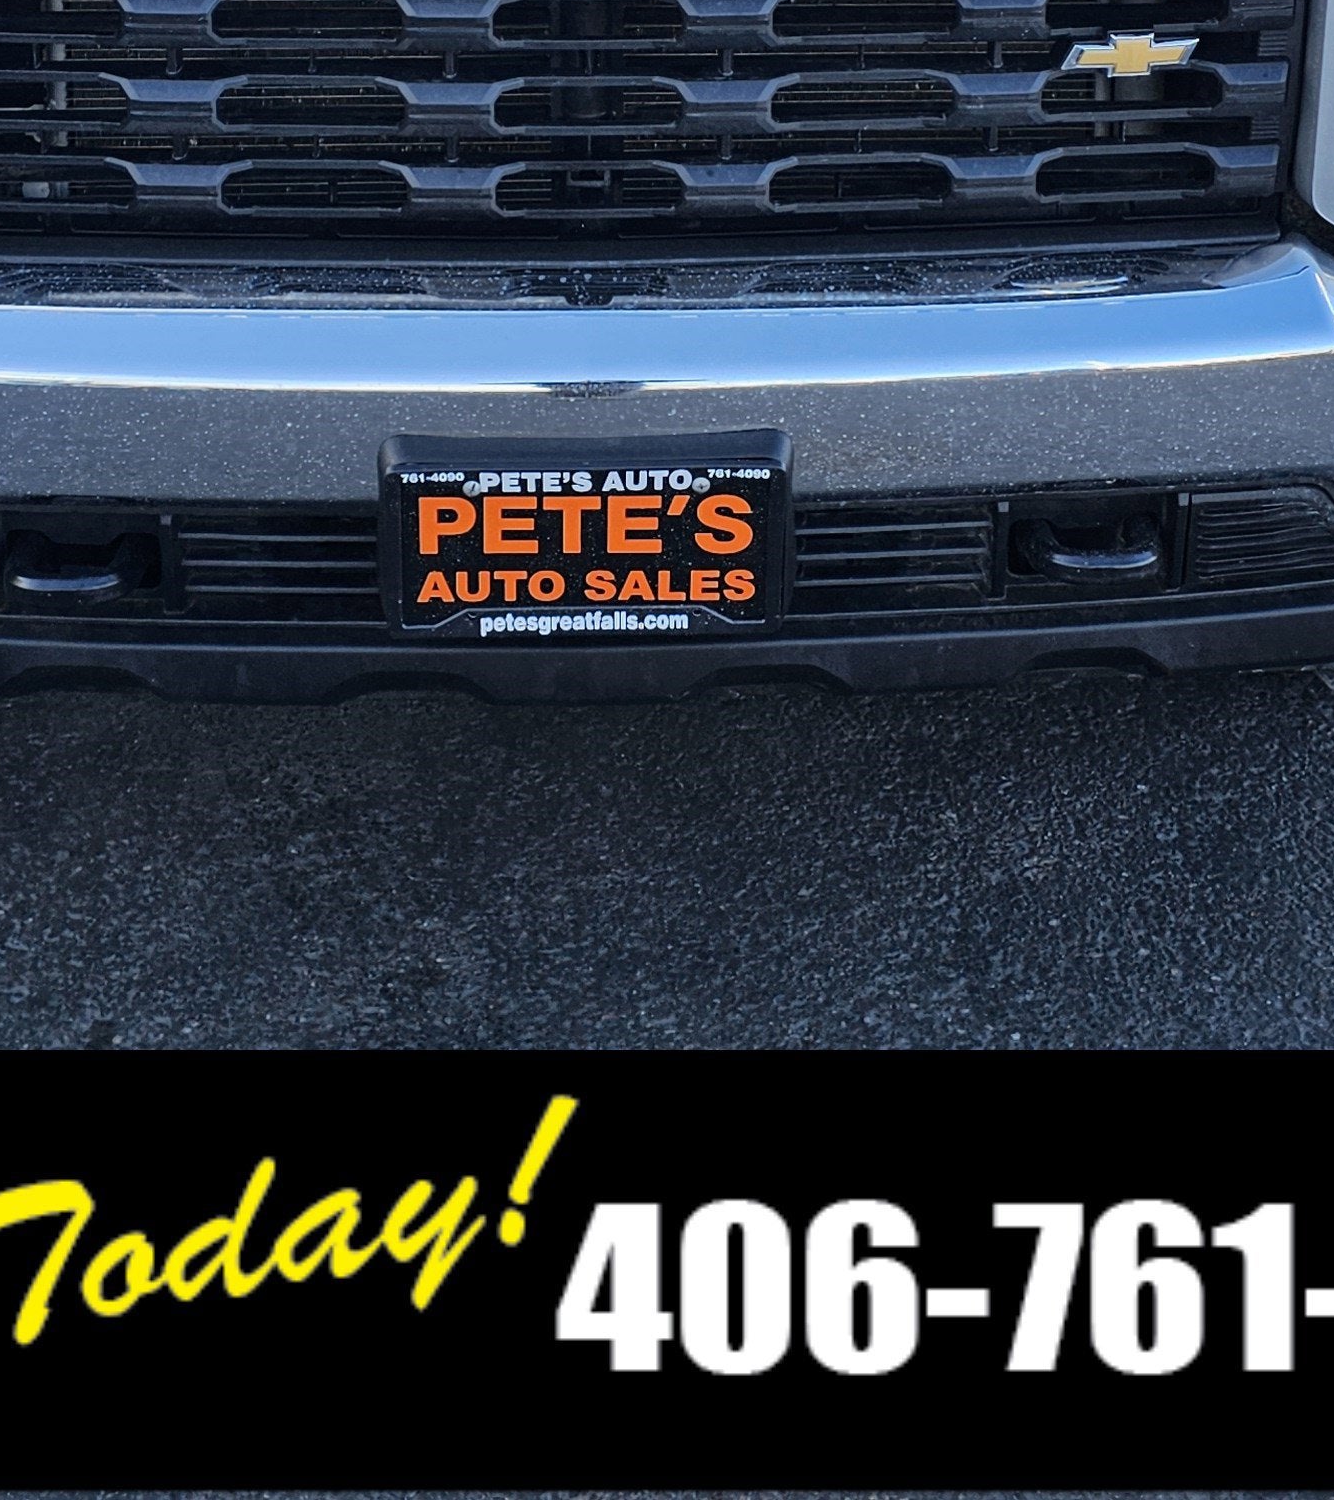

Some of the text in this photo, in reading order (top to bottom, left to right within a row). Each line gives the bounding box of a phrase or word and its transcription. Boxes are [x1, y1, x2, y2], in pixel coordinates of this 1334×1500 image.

[400, 471, 466, 484] 761-4090
[478, 469, 693, 493] PETE'S AUTO
[707, 468, 771, 480] 761-4090
[418, 494, 754, 555] PETE'S
[417, 569, 756, 603] AUTO SALES
[480, 610, 689, 637] petesgreatfalls.com
